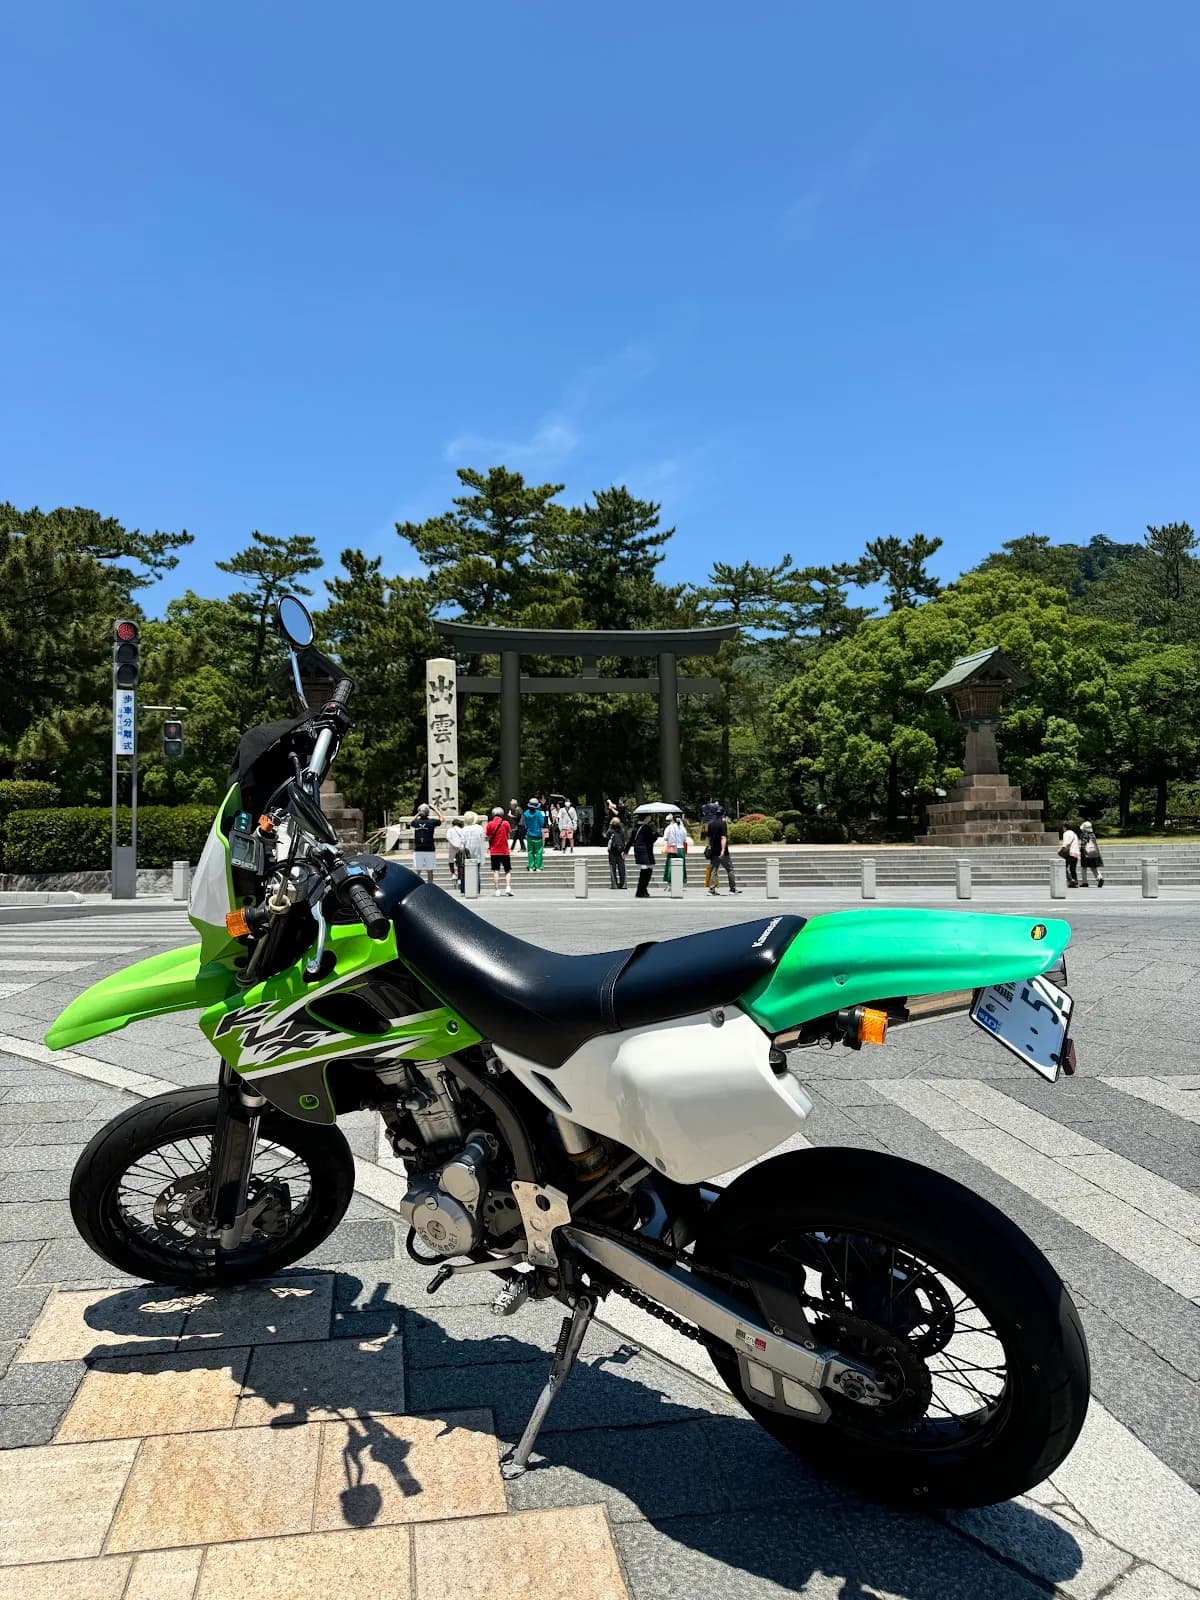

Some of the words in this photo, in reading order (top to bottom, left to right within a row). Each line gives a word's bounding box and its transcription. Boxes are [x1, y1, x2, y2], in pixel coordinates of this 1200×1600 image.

[122, 694, 133, 750] 歩車分離式
[428, 674, 457, 811] 出雲大社
[213, 1000, 331, 1065] KLX
